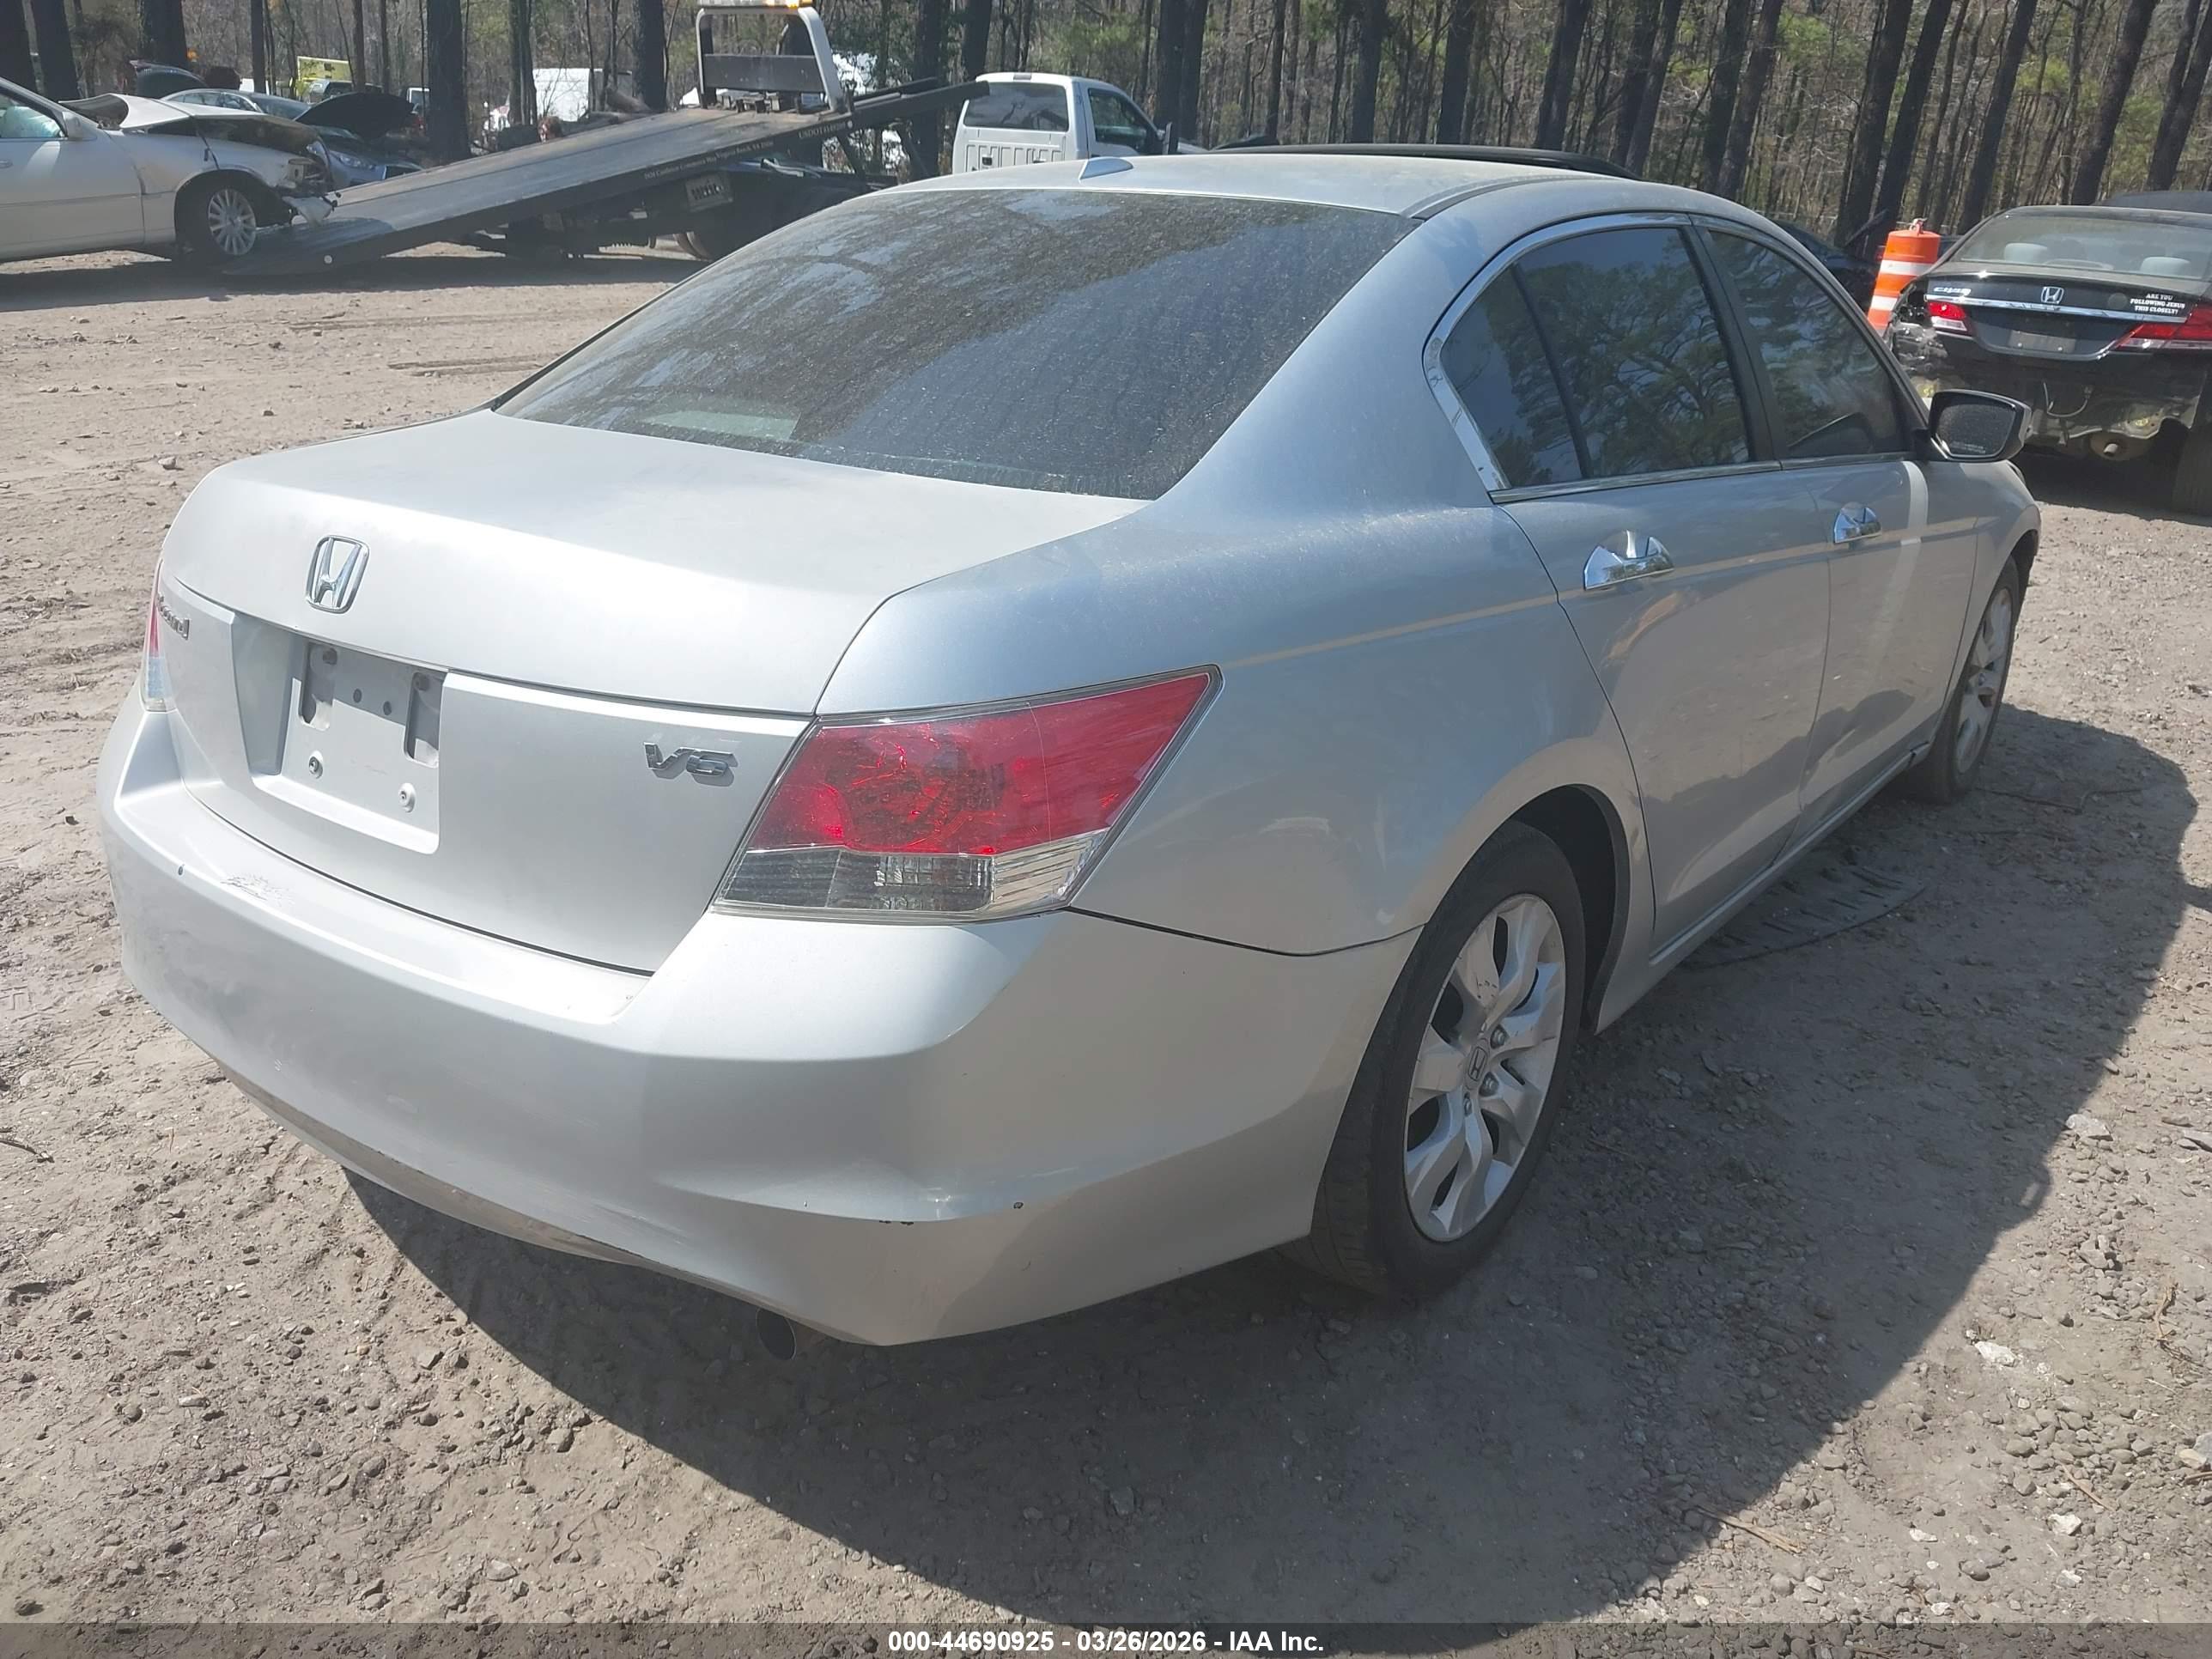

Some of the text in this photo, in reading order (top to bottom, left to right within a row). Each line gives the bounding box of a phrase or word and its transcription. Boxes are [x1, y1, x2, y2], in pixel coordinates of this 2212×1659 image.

[2130, 298, 2166, 307] FOLLOWING
[2149, 306, 2179, 315] CLOSELY?
[643, 741, 736, 777] V6
